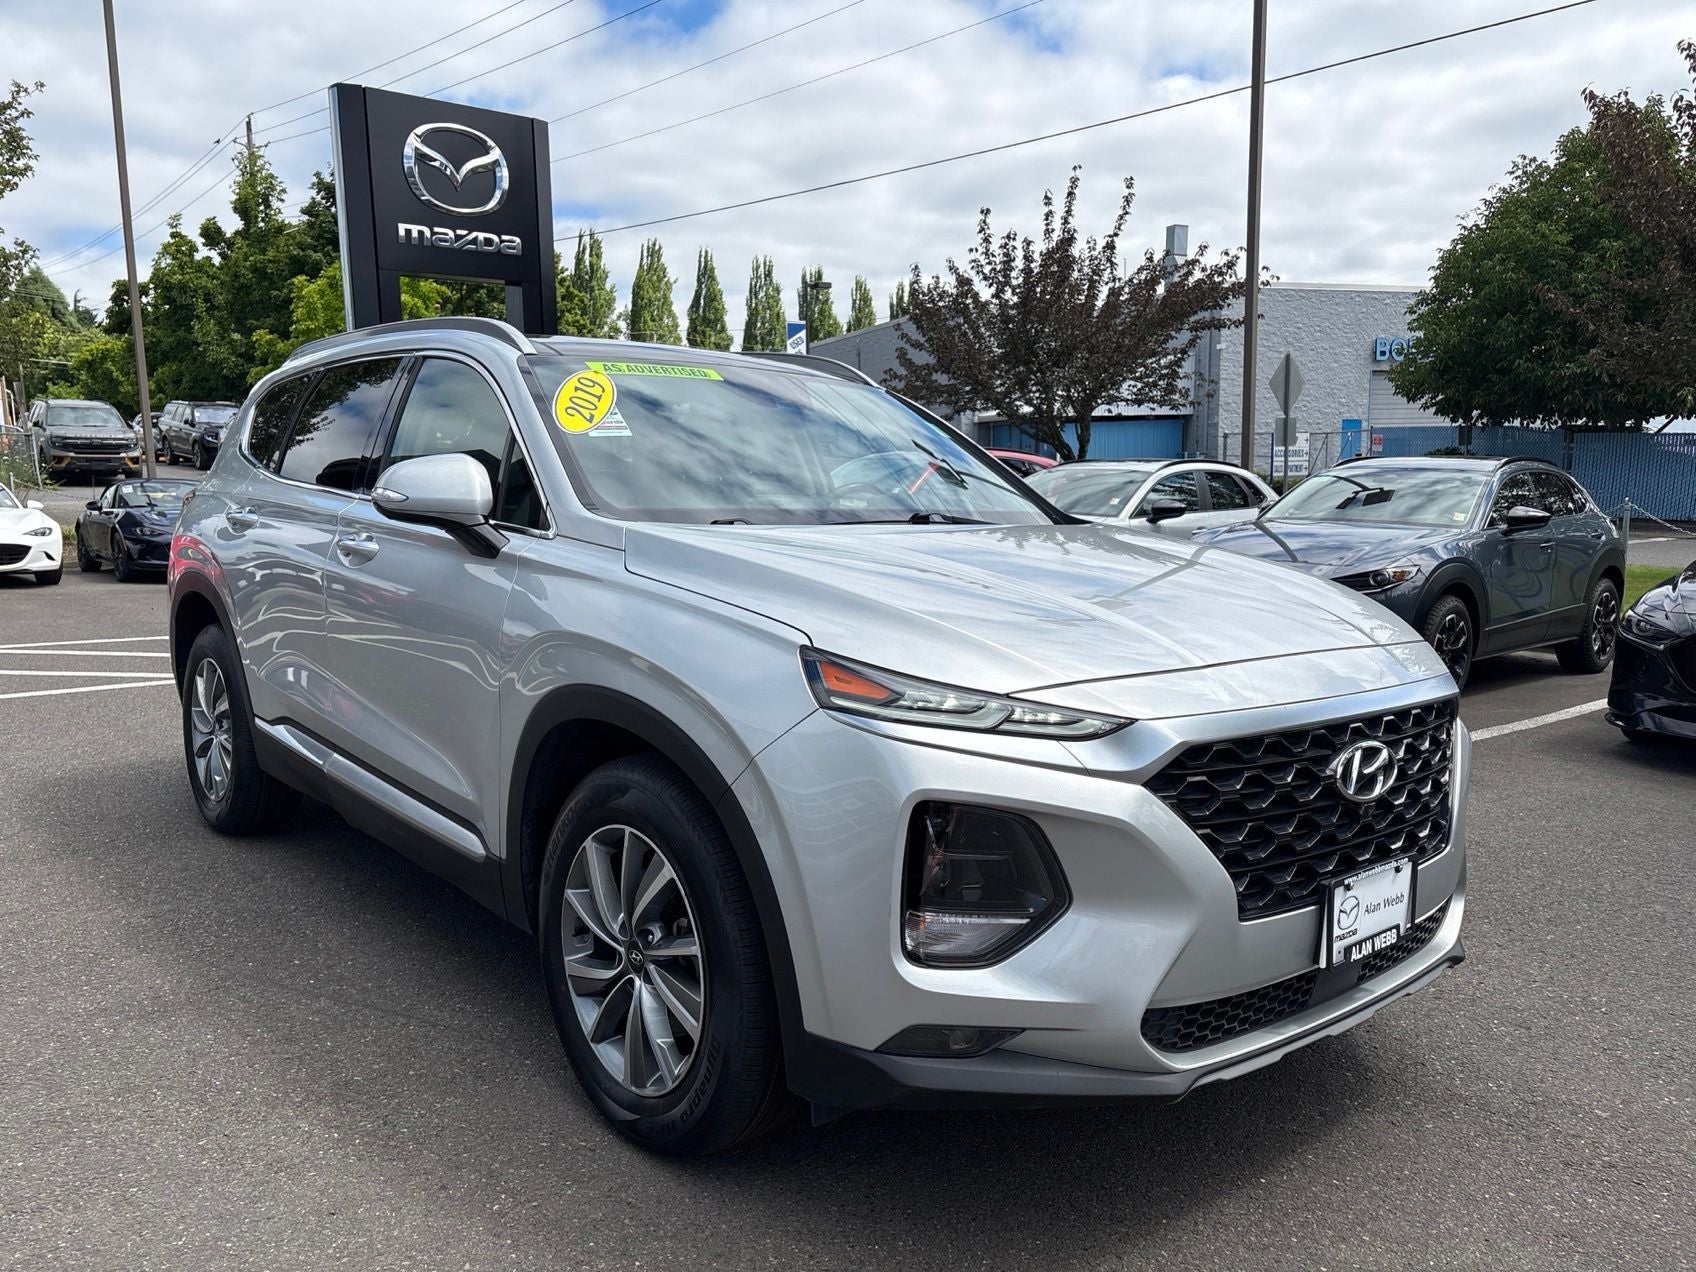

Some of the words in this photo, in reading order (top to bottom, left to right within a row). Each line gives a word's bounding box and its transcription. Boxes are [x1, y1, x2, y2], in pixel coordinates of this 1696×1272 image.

[1375, 338, 1414, 361] BO
[625, 364, 709, 378] ADVERTISED
[565, 376, 605, 424] 2019
[1274, 448, 1304, 457] ACCSORIES
[1363, 902, 1381, 916] Alan
[1383, 893, 1405, 909] Webb
[1351, 938, 1373, 962] ALAN
[1374, 928, 1397, 951] WEBB
